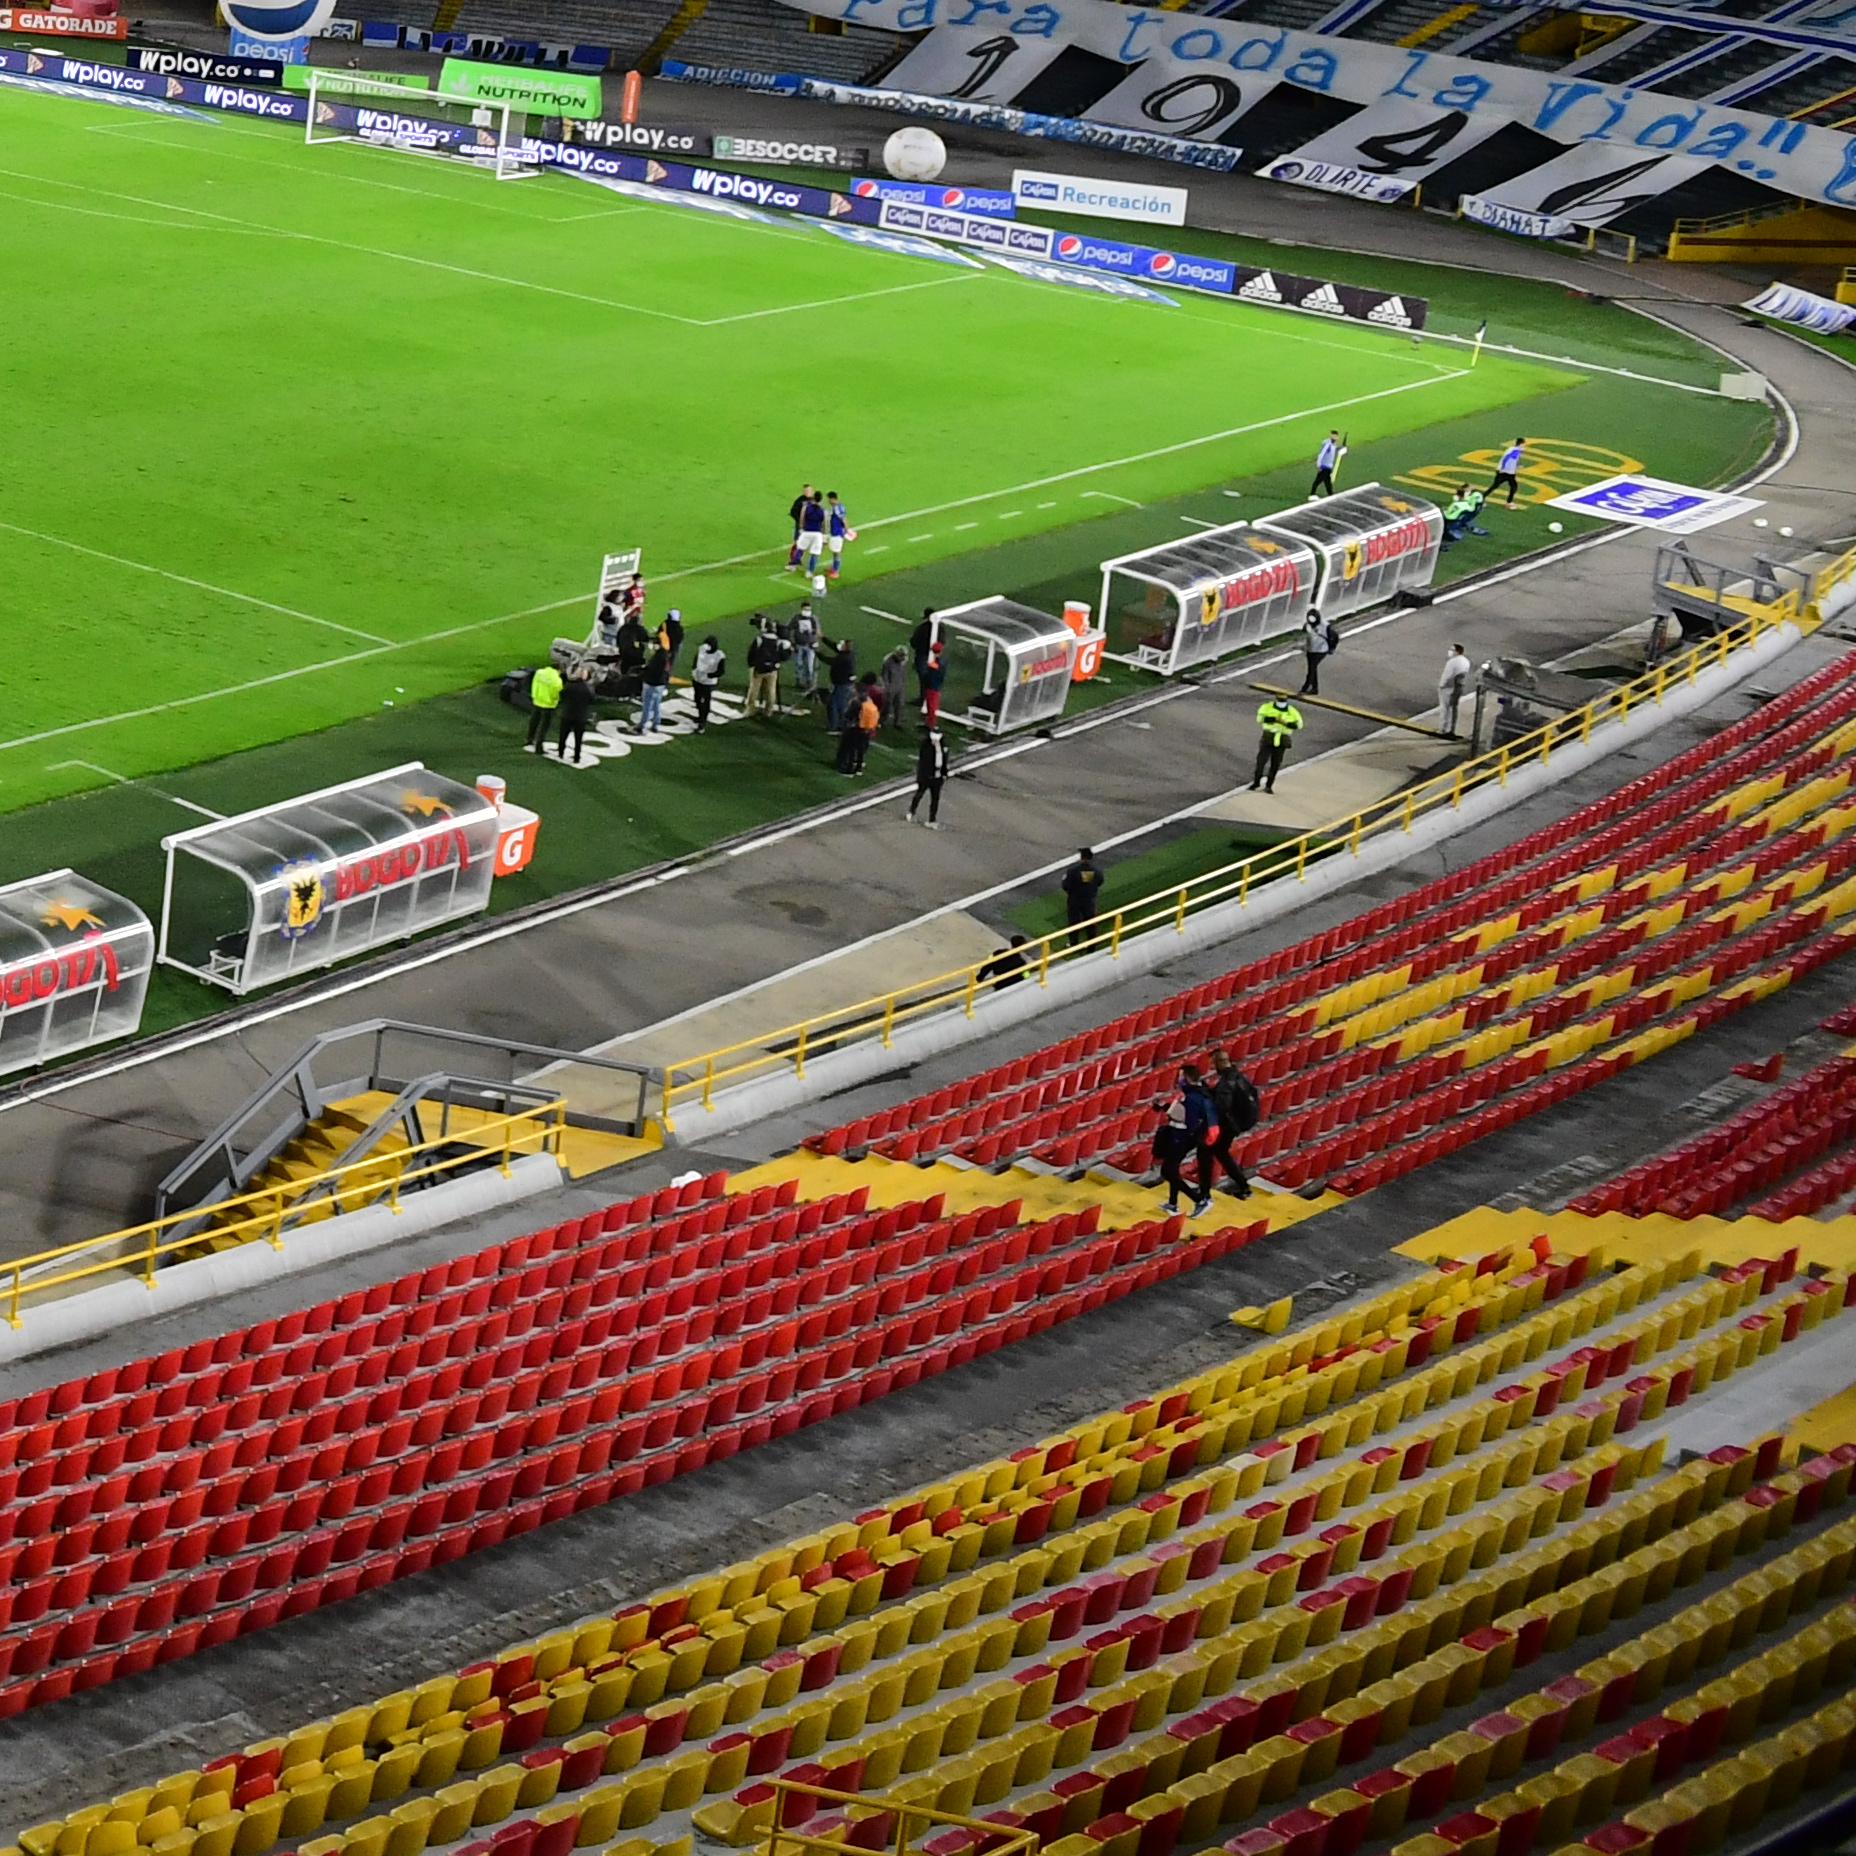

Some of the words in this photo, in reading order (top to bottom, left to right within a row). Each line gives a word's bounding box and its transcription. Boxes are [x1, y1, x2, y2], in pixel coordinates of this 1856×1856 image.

[18, 12, 117, 36] GATORADE
[138, 50, 239, 79] Wplay.co
[234, 42, 295, 63] pepsi
[1117, 10, 1338, 93] toda
[1383, 49, 1494, 114] la
[62, 59, 146, 92] Wplay.co
[204, 84, 293, 116] Wplay.co
[477, 84, 587, 110] NUTRITION
[585, 120, 694, 151] Wplay.co
[733, 138, 838, 164] BESOCCER
[692, 168, 801, 208] Wplay.co
[1062, 185, 1172, 215] Recreación
[966, 195, 1012, 214] pepsi
[1083, 245, 1133, 266] pepsi
[1177, 262, 1229, 284] pepsi
[1239, 286, 1282, 303] adidas
[1300, 298, 1345, 315] adidas
[1367, 310, 1412, 328] adidas
[1079, 642, 1098, 675] G
[501, 828, 526, 867] G
